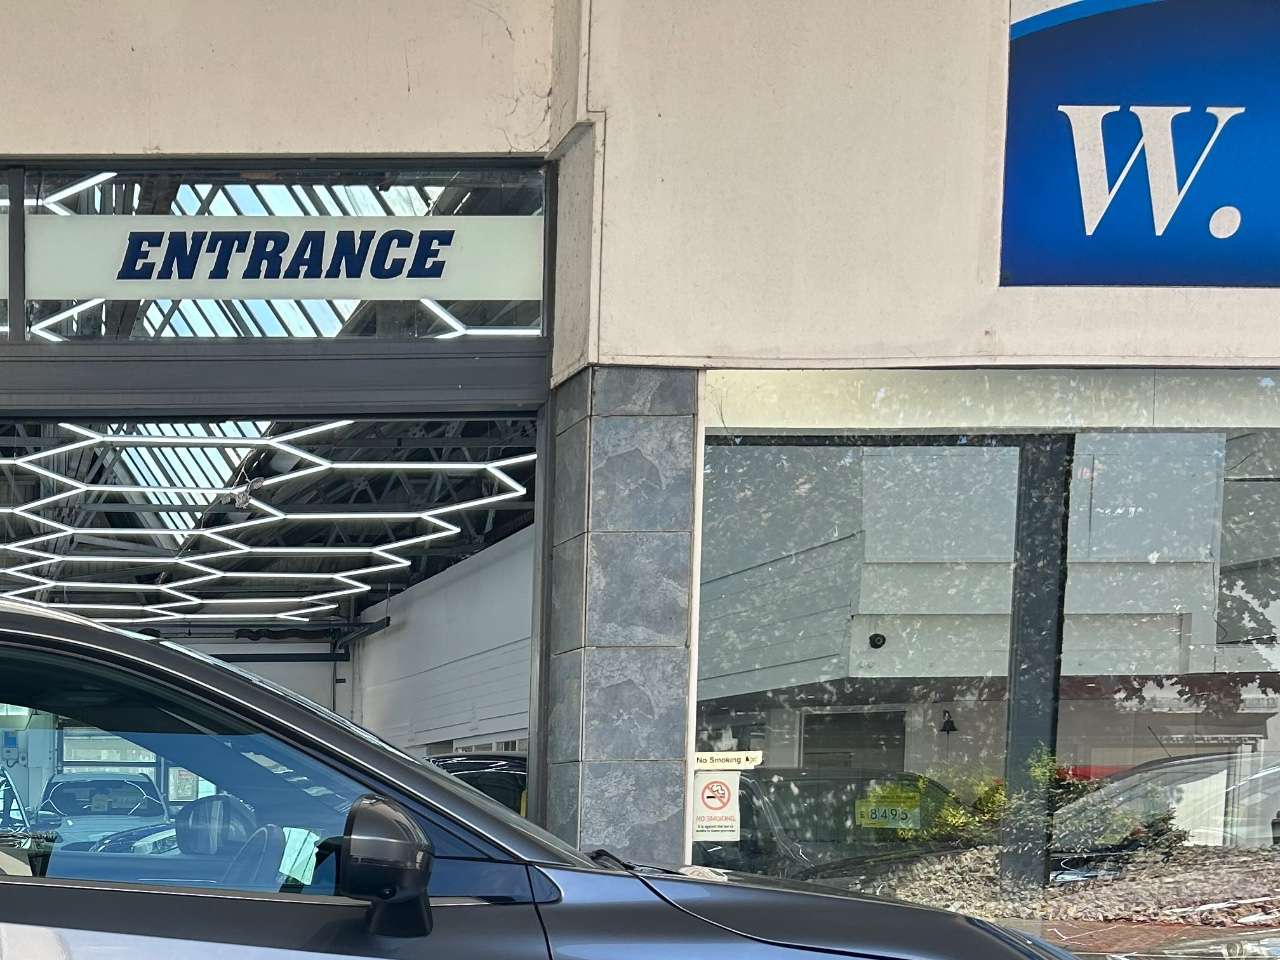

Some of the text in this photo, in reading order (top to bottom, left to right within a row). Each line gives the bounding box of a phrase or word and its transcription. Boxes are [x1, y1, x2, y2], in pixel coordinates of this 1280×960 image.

[1057, 104, 1246, 239] W.
[116, 229, 456, 281] ENTRANCE
[696, 756, 742, 765] No Smoking
